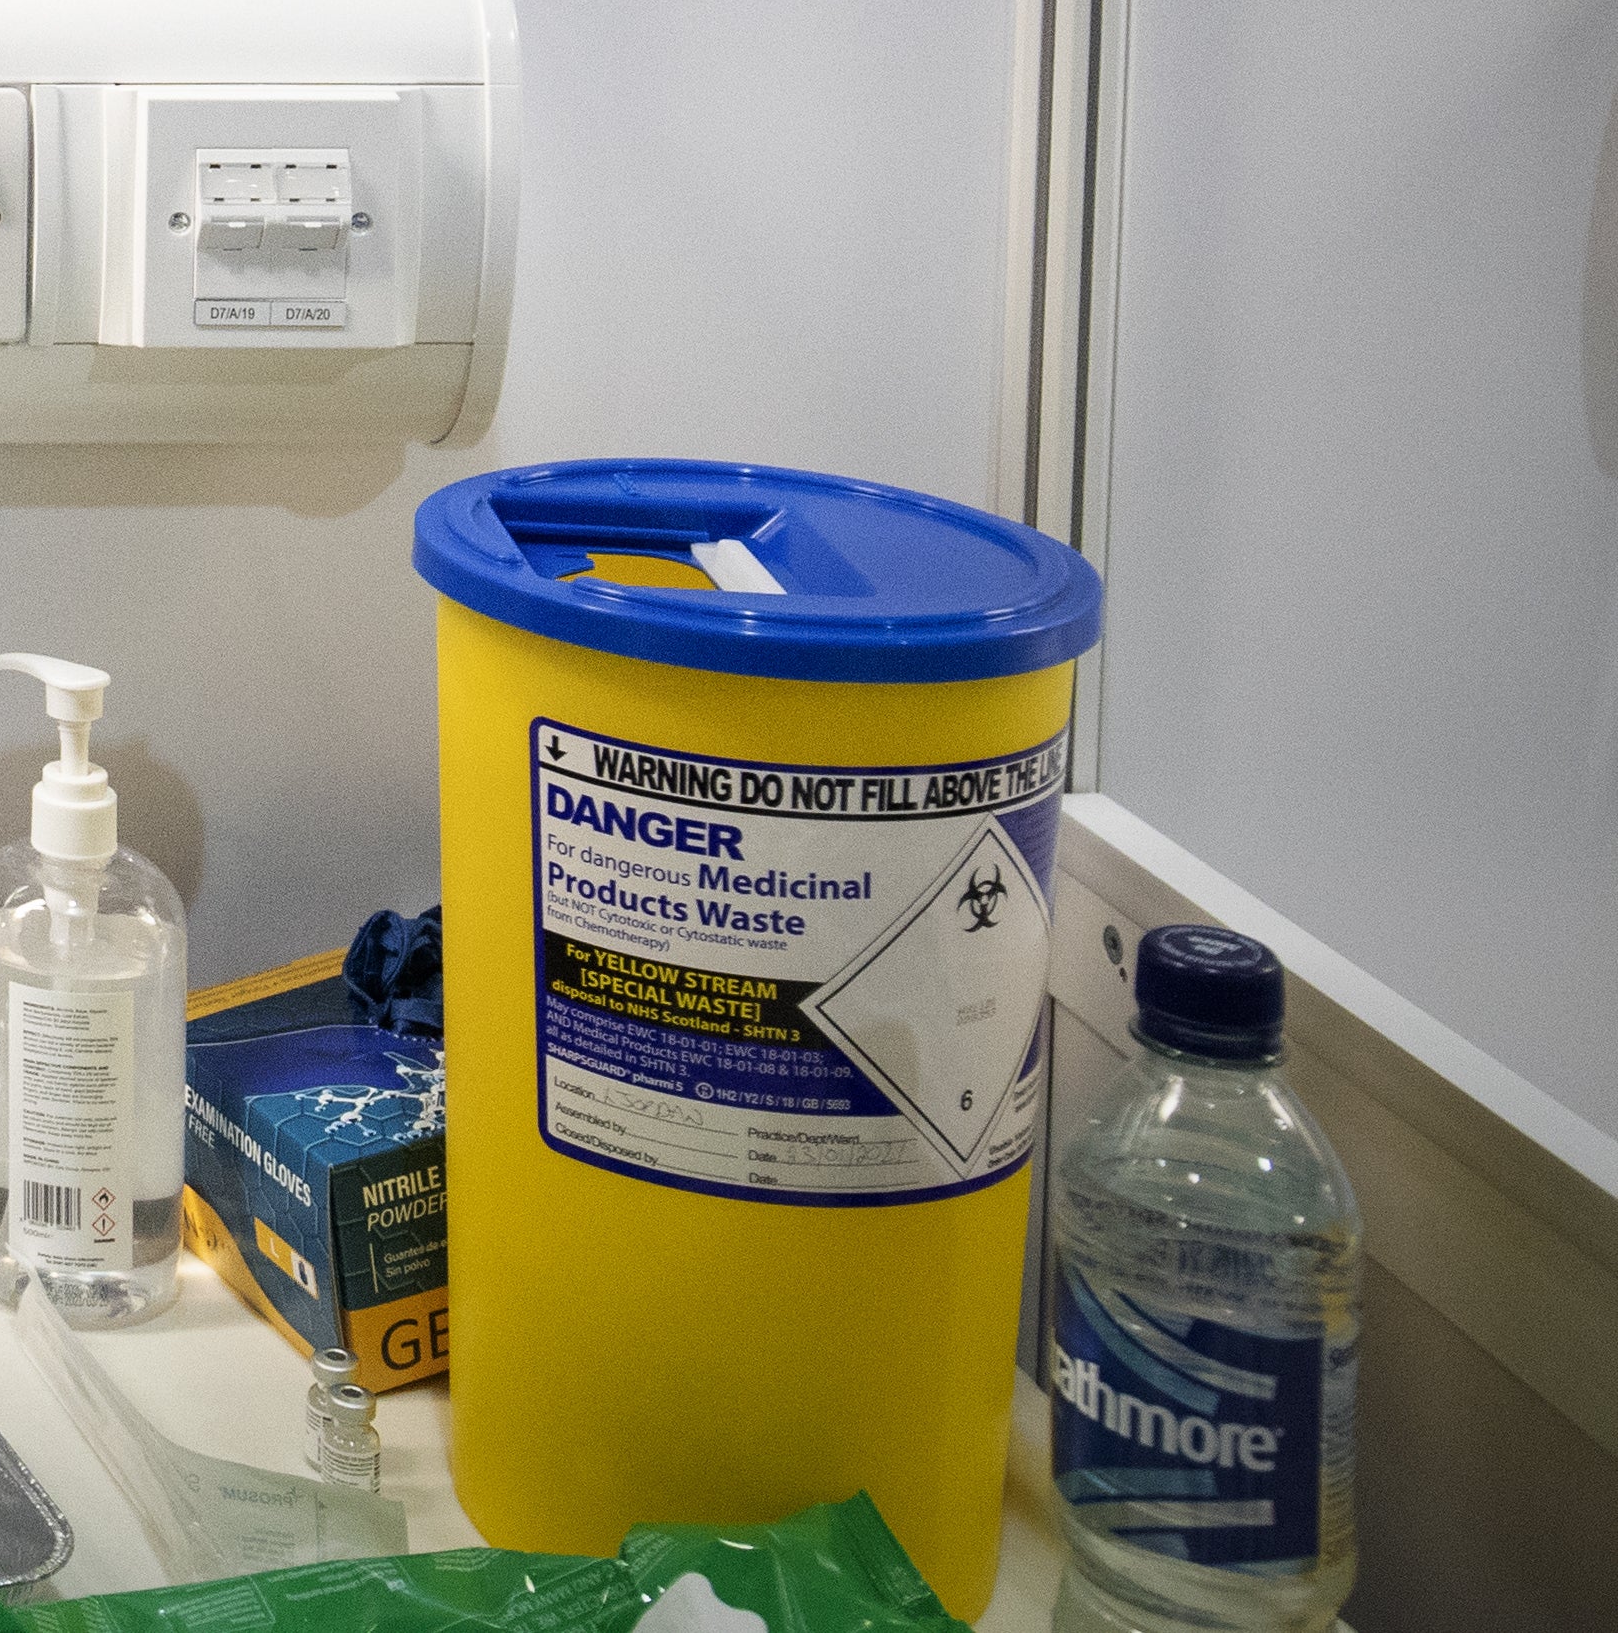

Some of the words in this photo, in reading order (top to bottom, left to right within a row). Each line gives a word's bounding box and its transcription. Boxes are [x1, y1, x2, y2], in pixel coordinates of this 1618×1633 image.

[209, 307, 255, 320] D7/A/19
[285, 307, 331, 321] D7/A/20
[593, 743, 733, 803] WARNING
[740, 771, 783, 807] DO
[791, 776, 855, 812] NOT
[862, 777, 919, 812] FILL
[923, 767, 1002, 810] ABOVE
[1006, 756, 1038, 797] THE
[546, 782, 745, 862] DANGER
[547, 832, 576, 858] For
[580, 845, 692, 887] dangerous
[698, 863, 872, 901] Medicinal
[546, 889, 570, 907] (but
[571, 897, 597, 916] NOT
[598, 909, 658, 933] Cytotoxic
[659, 925, 674, 936] or
[676, 926, 744, 948] Cytostatic
[746, 936, 788, 951] waste
[548, 861, 688, 922] Products
[696, 898, 806, 936] Waste
[546, 904, 573, 925] from
[574, 915, 670, 952] Chemotherapy)
[566, 942, 592, 963] For
[594, 948, 680, 985] YELLOW
[684, 971, 778, 1000] STREAM
[579, 967, 672, 1006] [SPECIAL
[676, 990, 761, 1023] WASTE]
[546, 994, 570, 1016] May
[570, 1006, 624, 1032] comprise
[627, 1024, 658, 1042] EWC
[724, 1044, 758, 1059] EWC
[551, 978, 607, 1007] disposal
[609, 998, 624, 1012] to
[626, 1003, 660, 1021] NHS
[662, 1010, 731, 1034] Scotland
[743, 1025, 787, 1042] SHTN
[790, 1029, 801, 1042] 3
[546, 1009, 572, 1028] AND
[573, 1020, 619, 1045] Medical
[623, 1036, 678, 1060] Products
[681, 1051, 713, 1067] EWC
[778, 1064, 789, 1076] &
[546, 1025, 559, 1037] all
[560, 1032, 573, 1044] as
[574, 1036, 622, 1061] detailed
[625, 1051, 637, 1064] in
[639, 1056, 676, 1074] SHTN
[553, 1075, 596, 1102] Location
[960, 1088, 974, 1112] 6
[188, 1113, 216, 1149] FREE
[554, 1100, 611, 1131] Assembled
[612, 1122, 628, 1137] by
[184, 1084, 262, 1167] EXAMINATION
[263, 1150, 312, 1207] GLOVES
[643, 1151, 660, 1167] by
[747, 1149, 778, 1163] Date
[362, 1165, 441, 1209] NITRILE
[748, 1171, 779, 1185] Date
[269, 1237, 280, 1259] L
[385, 1266, 402, 1278] Sin
